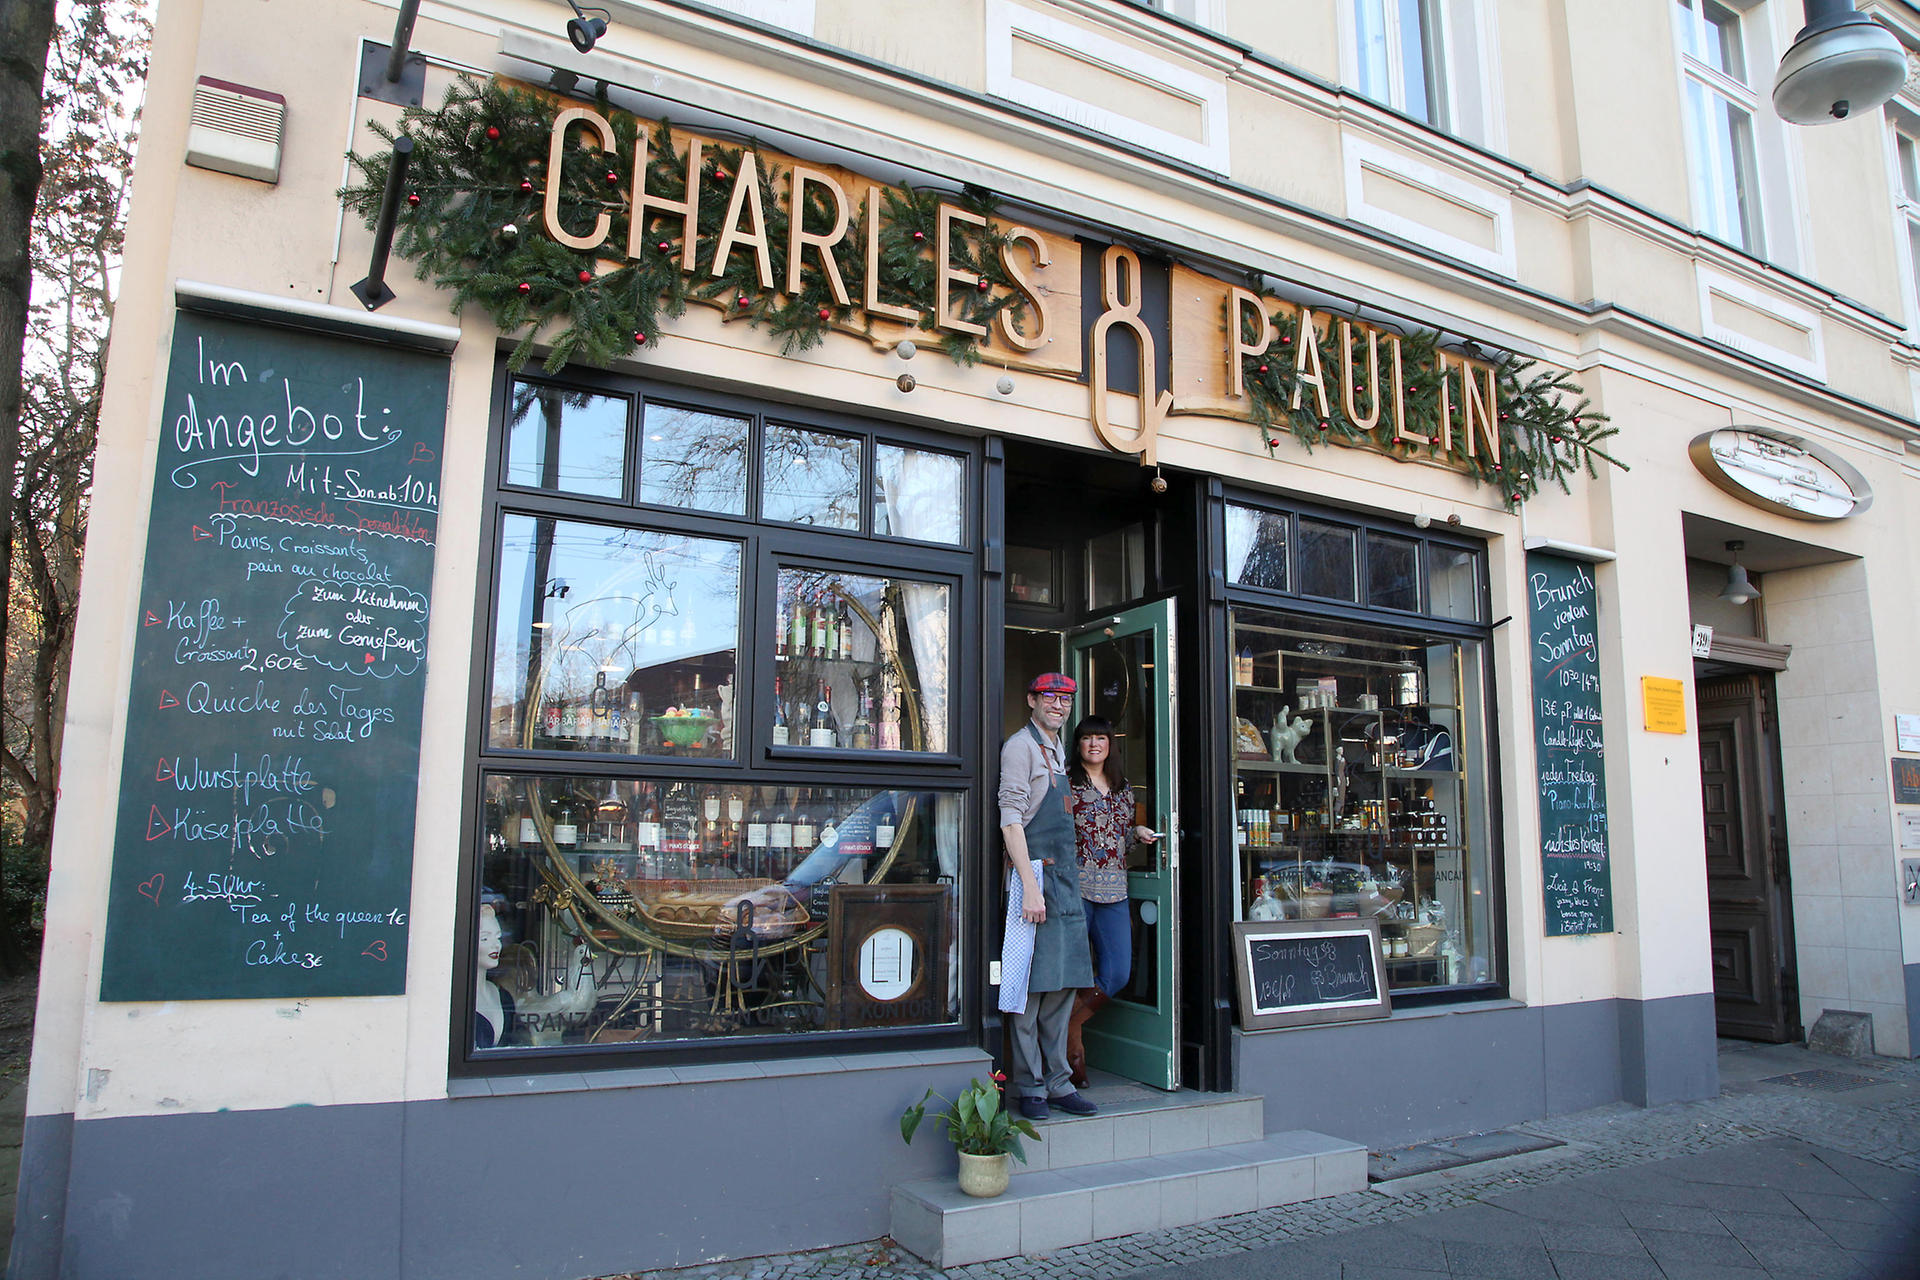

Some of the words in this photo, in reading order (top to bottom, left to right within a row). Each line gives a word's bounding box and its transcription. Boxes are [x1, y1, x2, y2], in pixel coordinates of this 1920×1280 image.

[543, 106, 1051, 354] CHARLES
[1227, 287, 1501, 466] PAULIN
[198, 335, 248, 386] Im
[175, 377, 392, 477] Angebot:
[212, 518, 273, 552] Pains,
[279, 536, 369, 564] Croissants,
[246, 559, 284, 581] pain
[292, 564, 317, 577] au
[322, 562, 392, 582] chocolat
[1530, 565, 1595, 612] Brunch
[345, 609, 375, 625] oder
[350, 587, 426, 613] Mitnehmen
[1552, 604, 1590, 631] jeden
[166, 598, 226, 649] Kaffee
[174, 636, 251, 665] Croissant
[239, 648, 309, 672] 2,60€
[1538, 624, 1598, 664] Sonntag
[186, 680, 281, 716] Quiche
[292, 687, 329, 716] des
[328, 684, 396, 738] Tages
[272, 720, 305, 739] mit
[312, 721, 356, 742] Salat
[173, 752, 316, 805] Wurstplatte
[173, 804, 334, 849] Käseplatte
[229, 903, 271, 924] Tea
[280, 902, 297, 932] of
[304, 902, 330, 924] the
[336, 912, 383, 939] queen
[385, 907, 407, 926] 1€
[244, 940, 302, 967] Cake
[300, 952, 324, 969] 3€
[1323, 955, 1371, 988] Brunch
